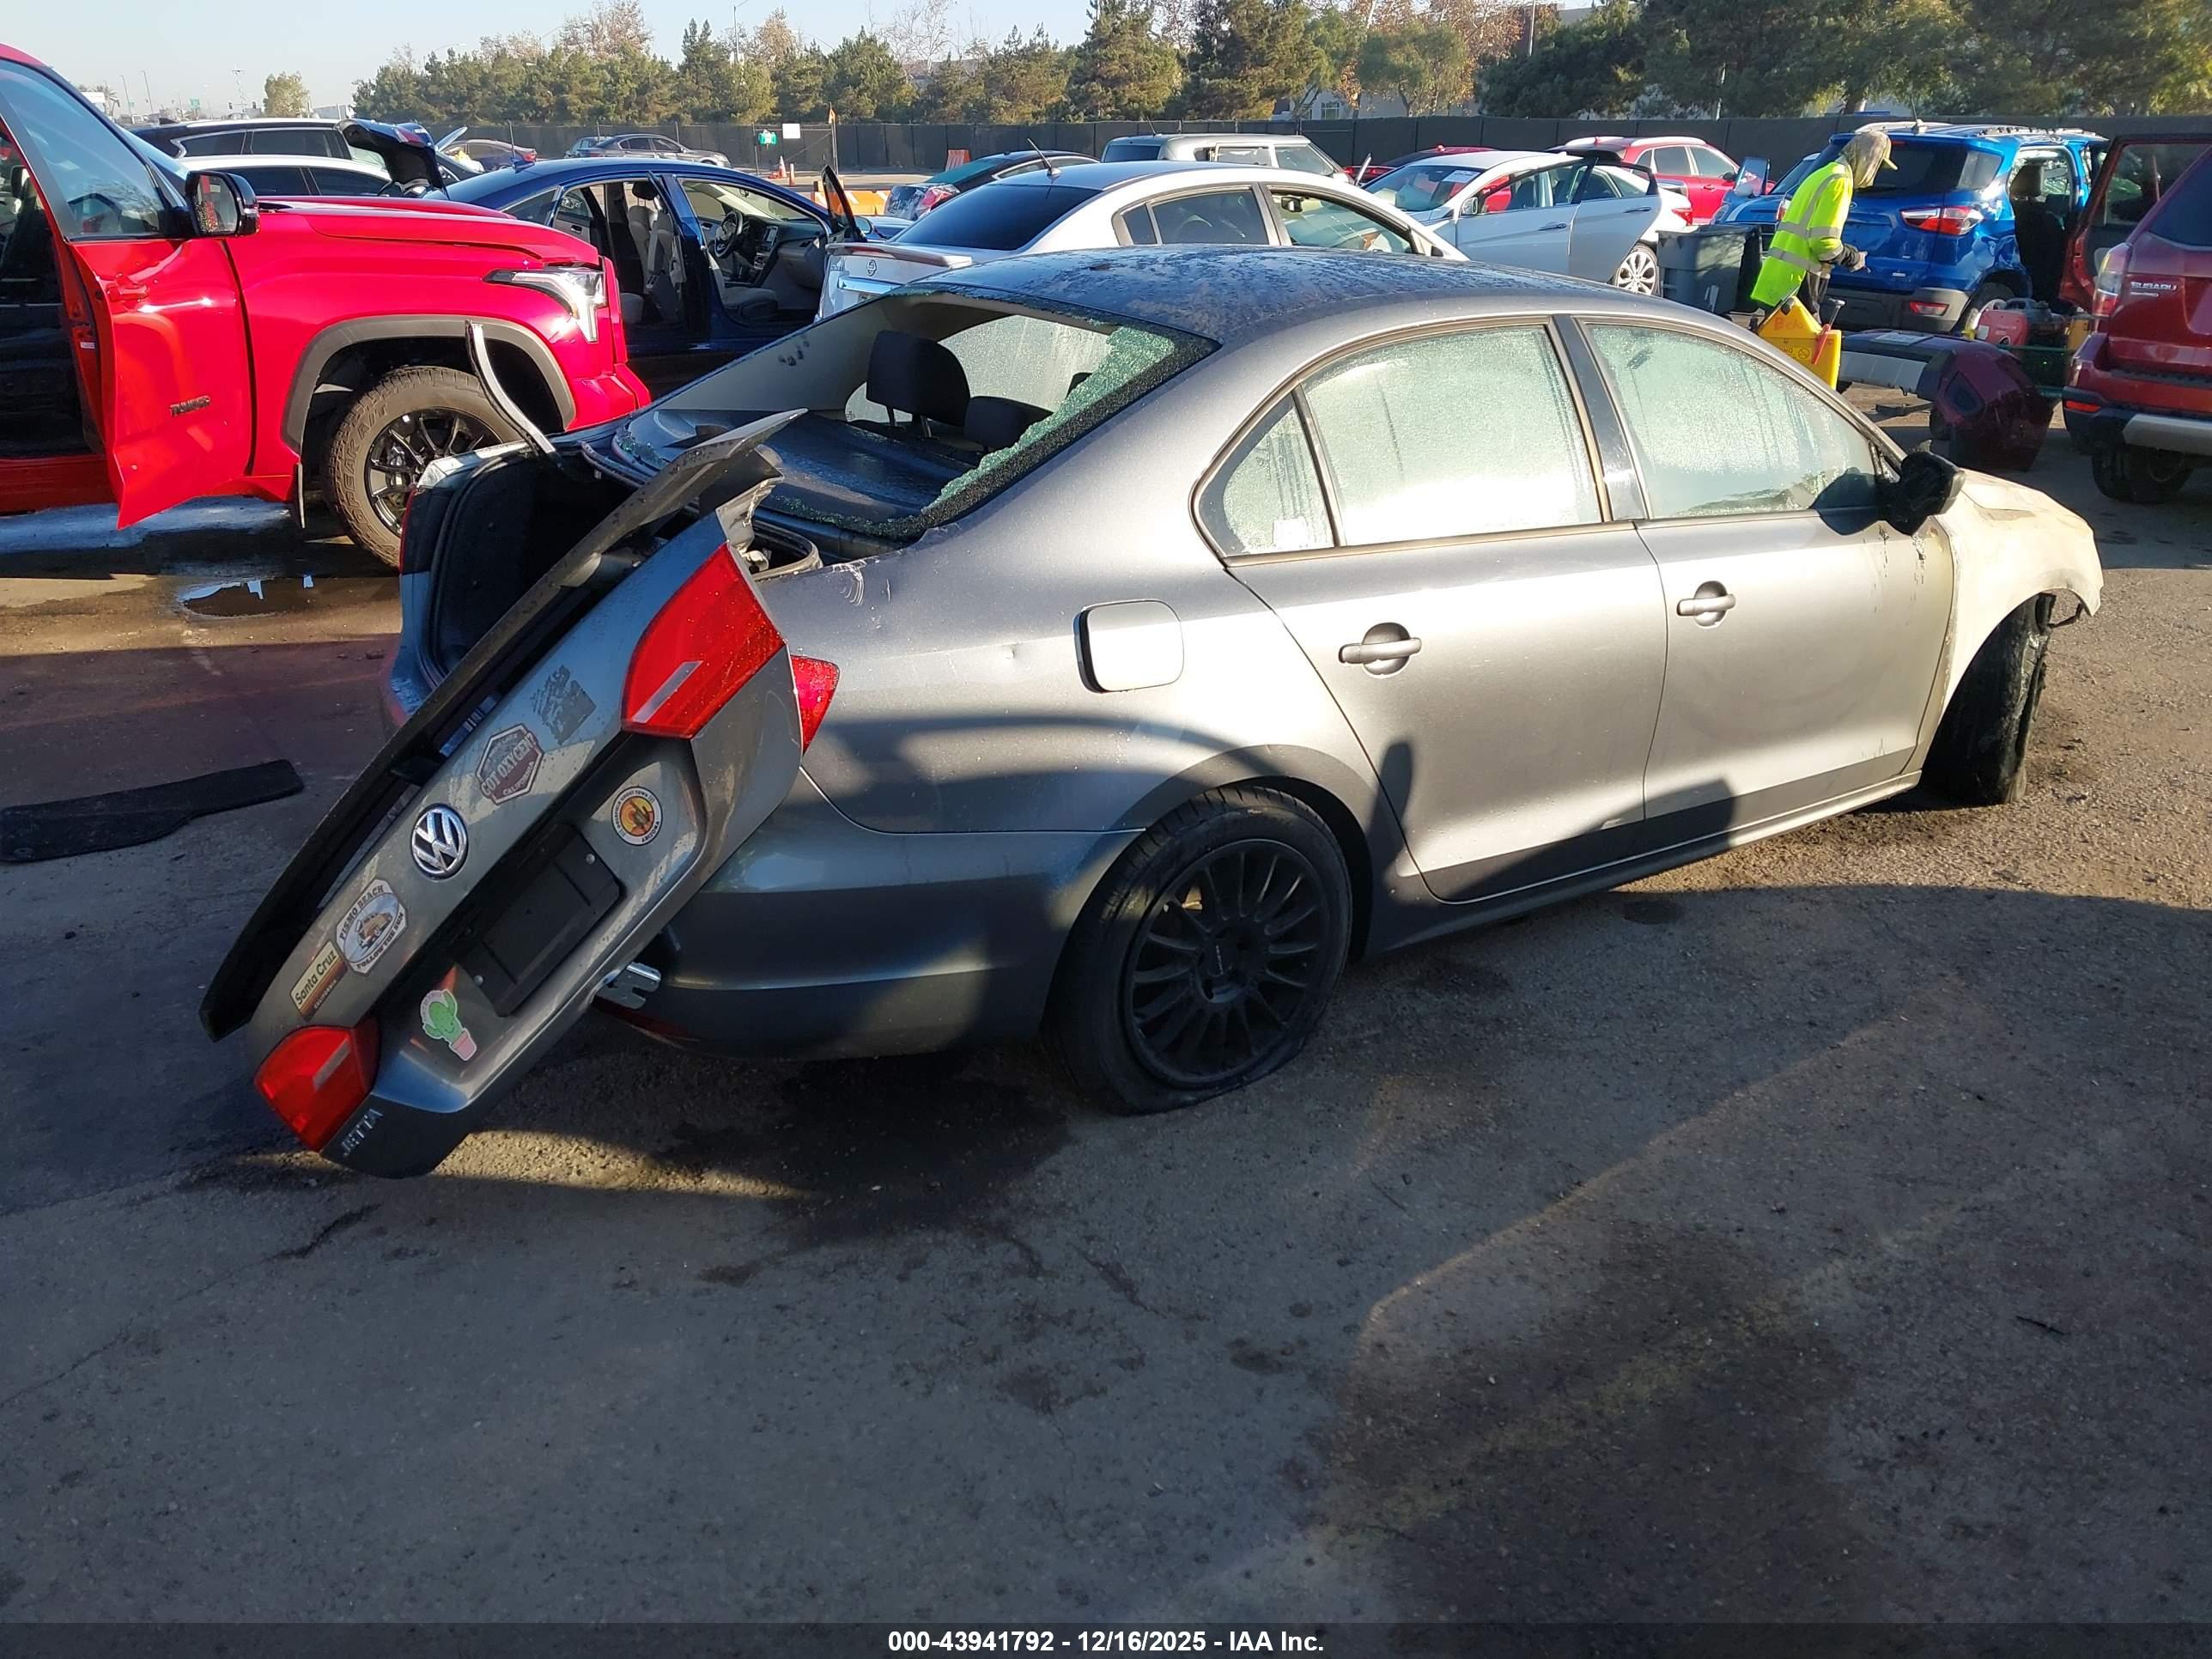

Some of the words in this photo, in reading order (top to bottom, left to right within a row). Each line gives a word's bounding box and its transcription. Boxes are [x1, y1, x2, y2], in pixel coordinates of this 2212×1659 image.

[2130, 281, 2178, 291] SUBARU
[339, 908, 358, 940] PISMO
[357, 885, 384, 908] BEACH
[295, 974, 319, 1005] Santa
[316, 950, 337, 975] Cruz
[356, 945, 384, 969] FOLLOW
[342, 1108, 384, 1158] JETTA
